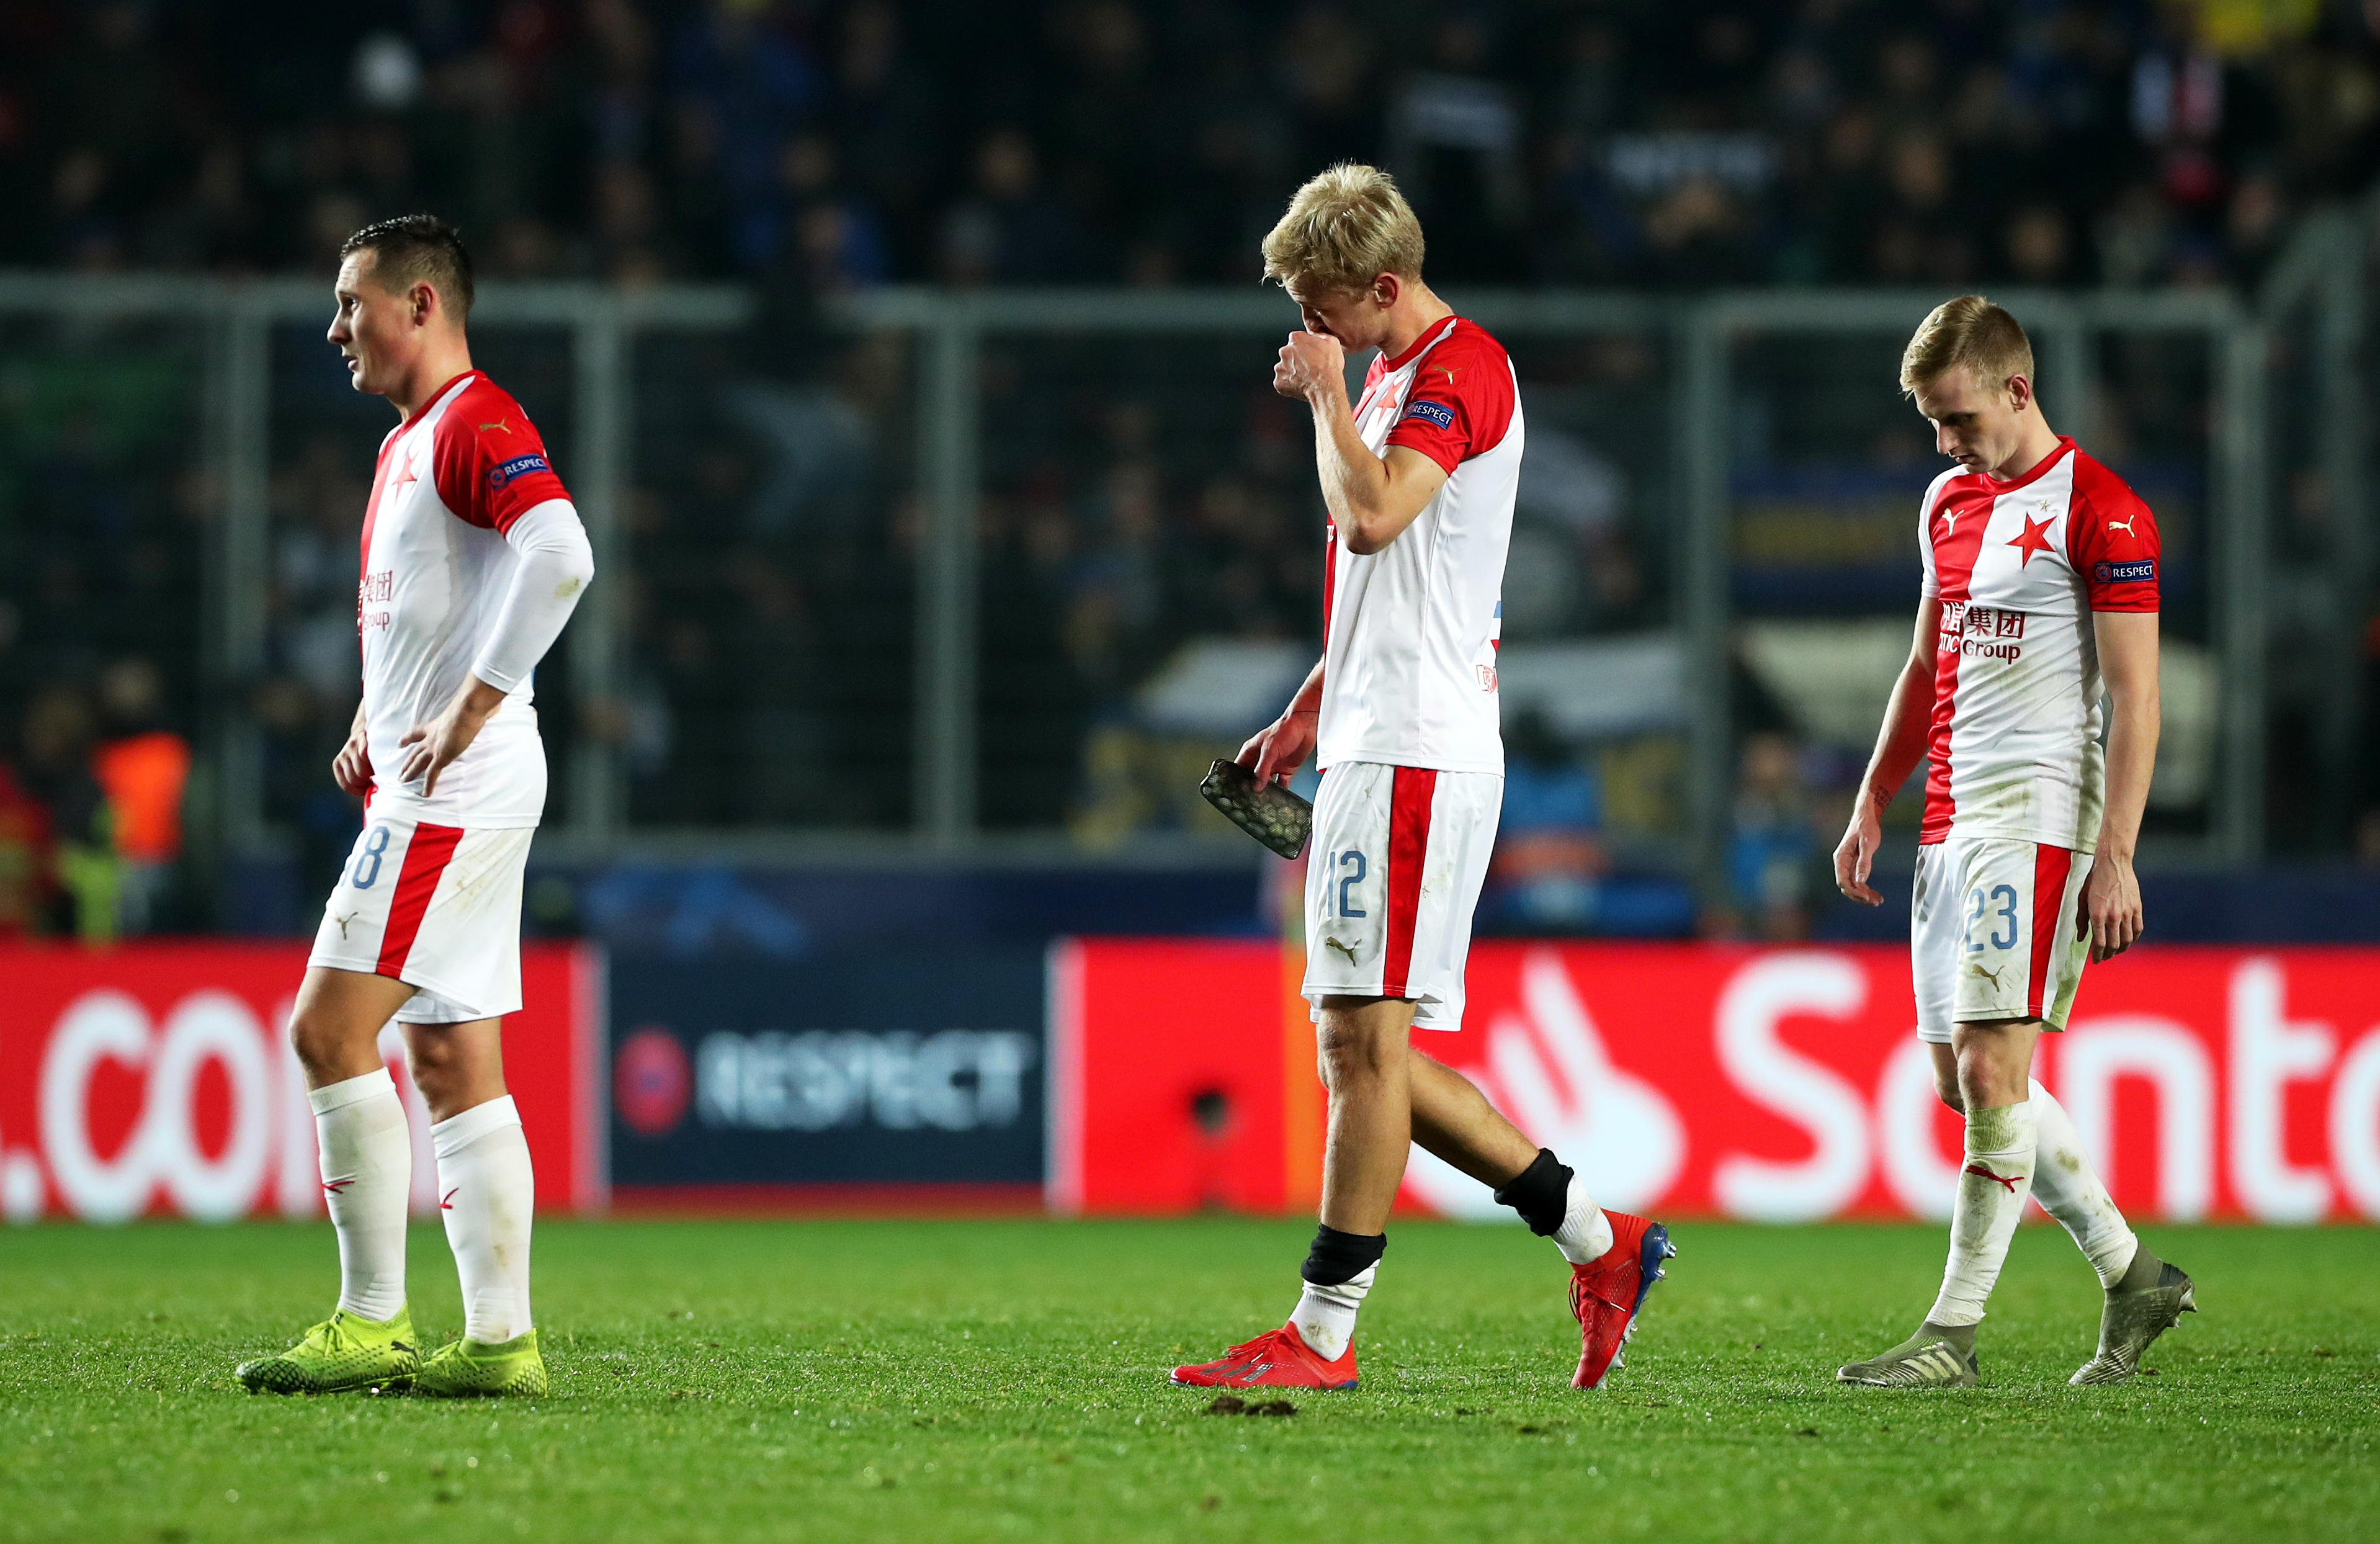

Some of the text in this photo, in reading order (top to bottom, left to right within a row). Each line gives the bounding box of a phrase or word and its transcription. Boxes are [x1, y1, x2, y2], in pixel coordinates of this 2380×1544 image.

[1413, 405, 1452, 424] RESPECT
[504, 458, 545, 476] RESPEC
[2113, 565, 2153, 578] RESPECT
[1962, 639, 2021, 665] Group
[1327, 850, 1367, 918] 12
[1965, 884, 2018, 953] 23
[695, 1028, 1037, 1132] RESPECT
